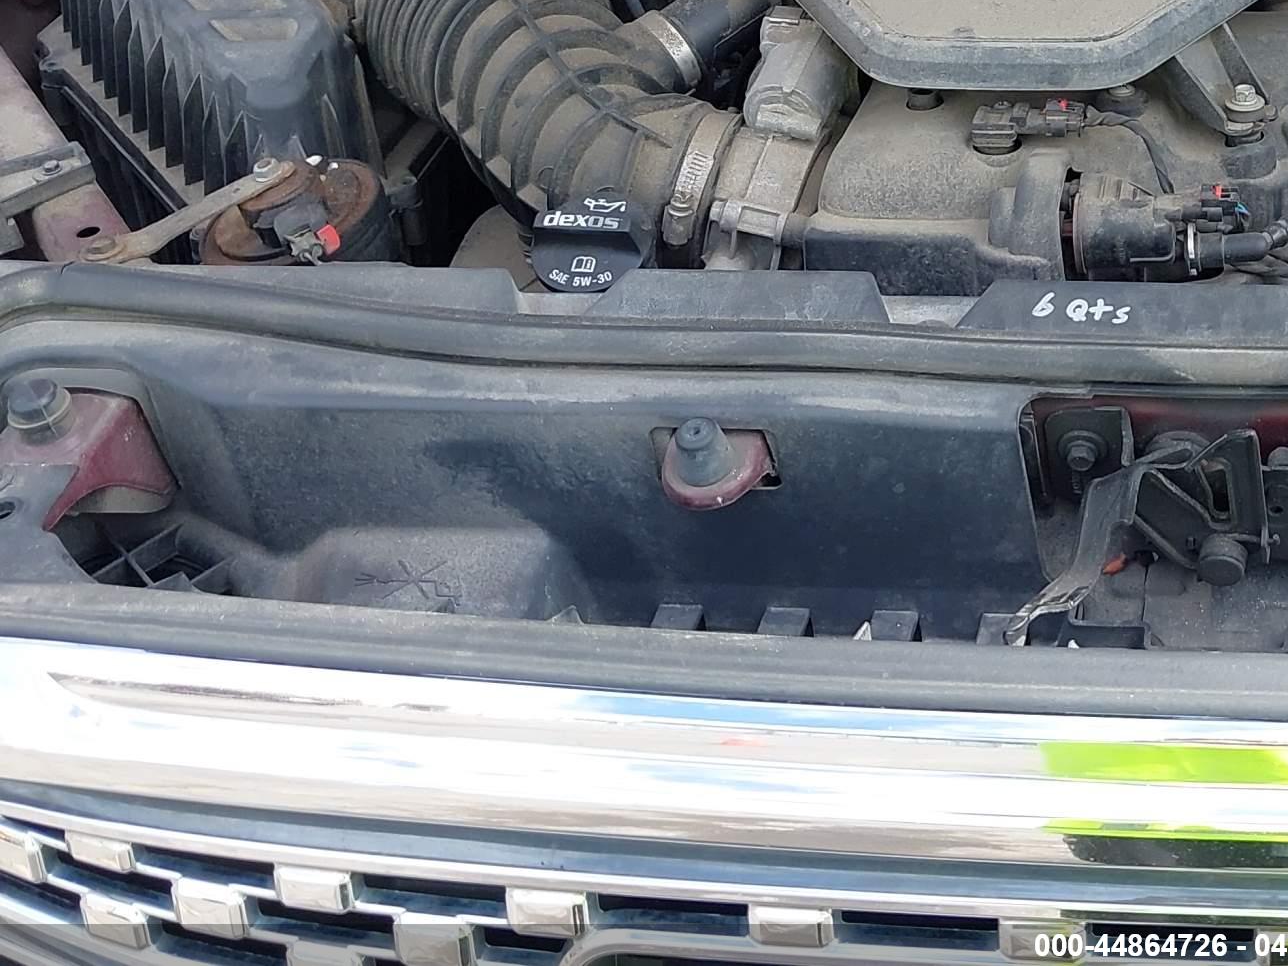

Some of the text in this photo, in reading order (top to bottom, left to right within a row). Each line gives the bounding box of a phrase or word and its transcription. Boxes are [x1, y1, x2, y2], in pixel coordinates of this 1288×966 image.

[543, 210, 620, 229] dexos
[548, 269, 613, 287] SAE 5W-30
[1031, 291, 1056, 317] 6
